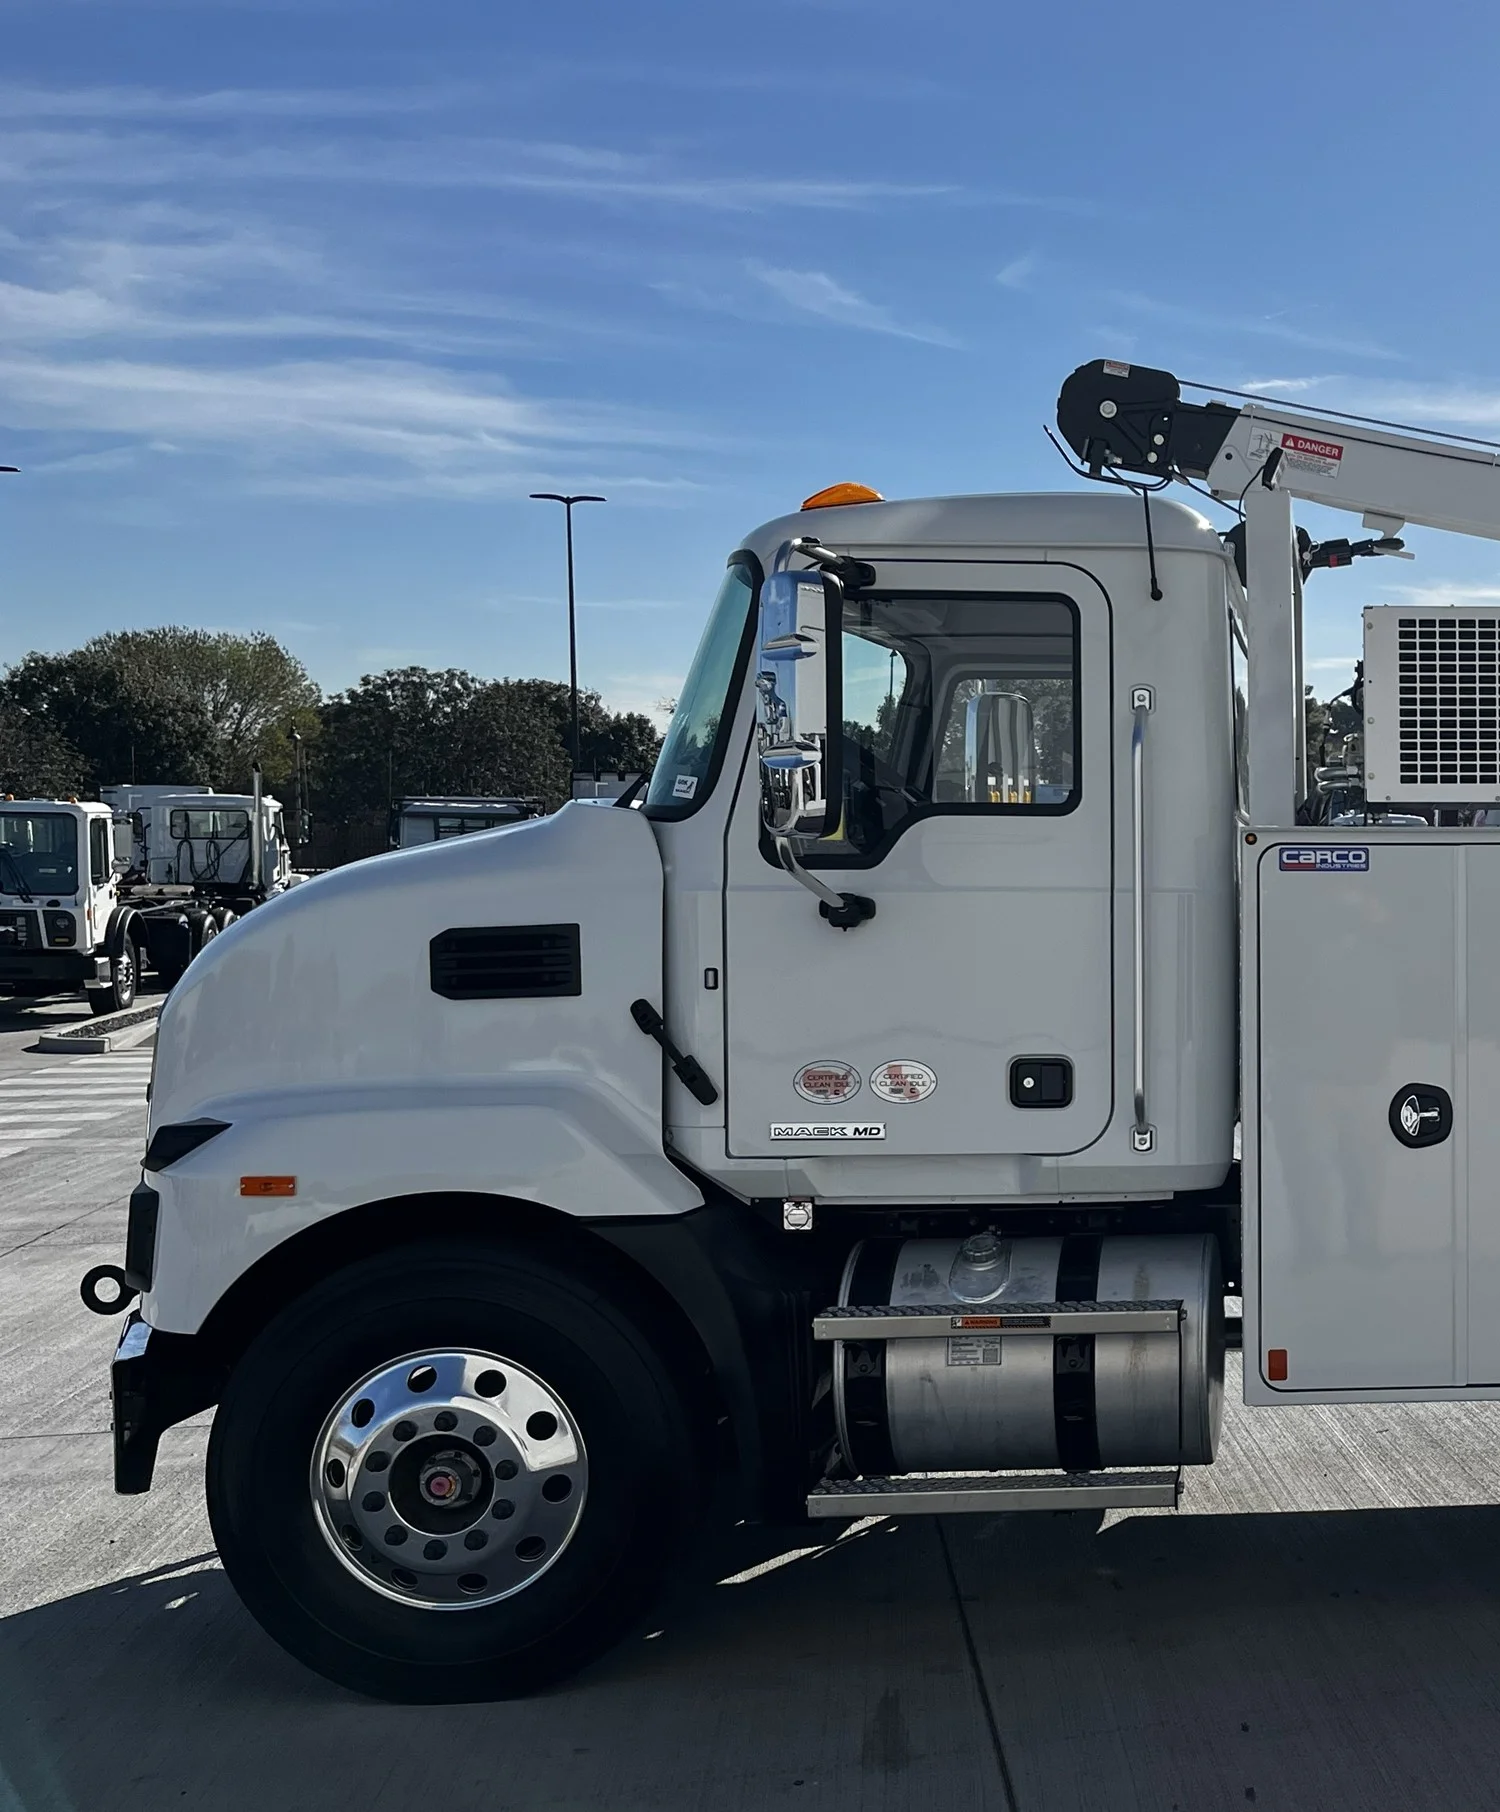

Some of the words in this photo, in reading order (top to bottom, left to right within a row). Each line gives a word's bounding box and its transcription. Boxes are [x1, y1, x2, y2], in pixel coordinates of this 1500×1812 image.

[1297, 440, 1339, 456] DANGER
[774, 1127, 848, 1136] MACK
[853, 1127, 881, 1136] MD
